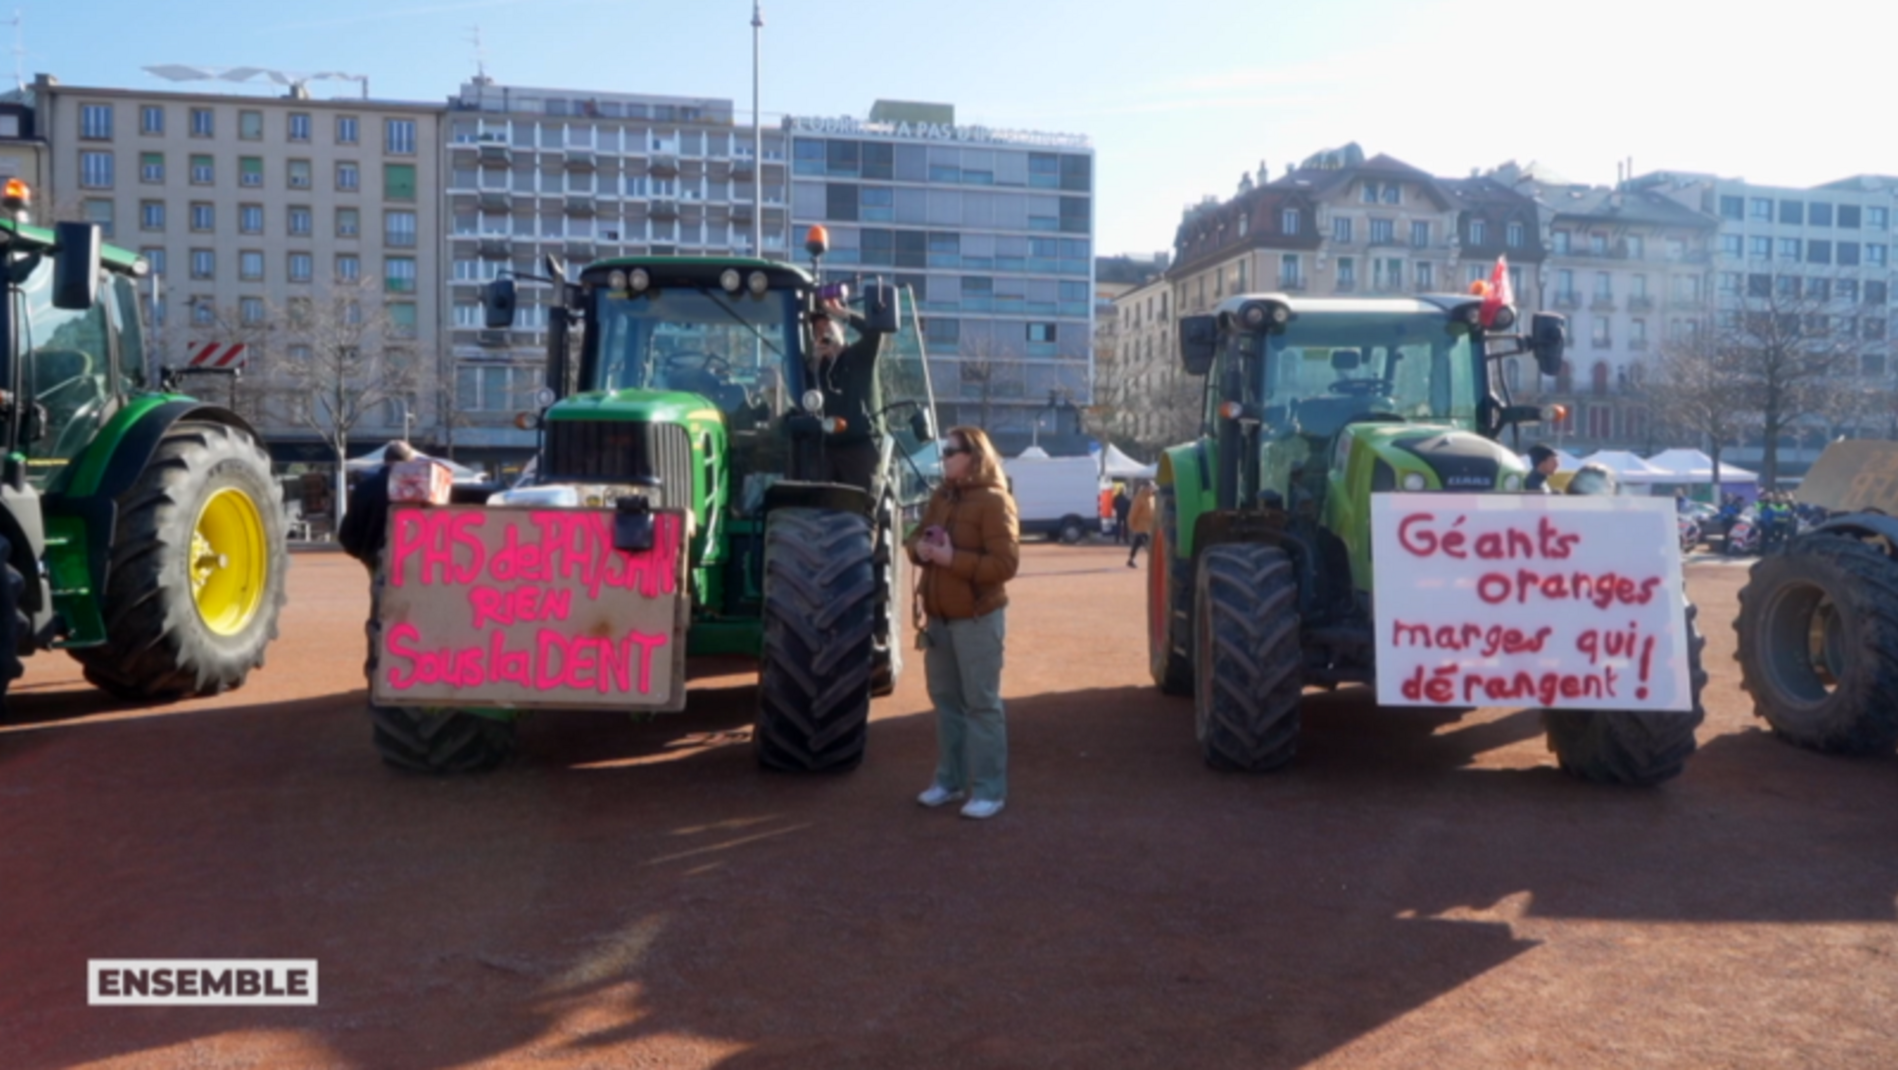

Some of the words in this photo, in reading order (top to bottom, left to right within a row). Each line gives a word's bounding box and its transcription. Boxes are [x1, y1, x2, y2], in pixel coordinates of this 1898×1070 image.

[916, 122, 951, 141] PAS
[391, 508, 487, 587] PAS
[1398, 512, 1580, 560] Géants
[468, 585, 573, 630] RIEN
[1477, 568, 1661, 608] oranges
[386, 623, 484, 690] Sous
[489, 631, 531, 688] la
[536, 629, 668, 695] DENT
[1393, 620, 1553, 658] marges
[1576, 621, 1638, 664] qui
[1401, 664, 1619, 706] dérangent
